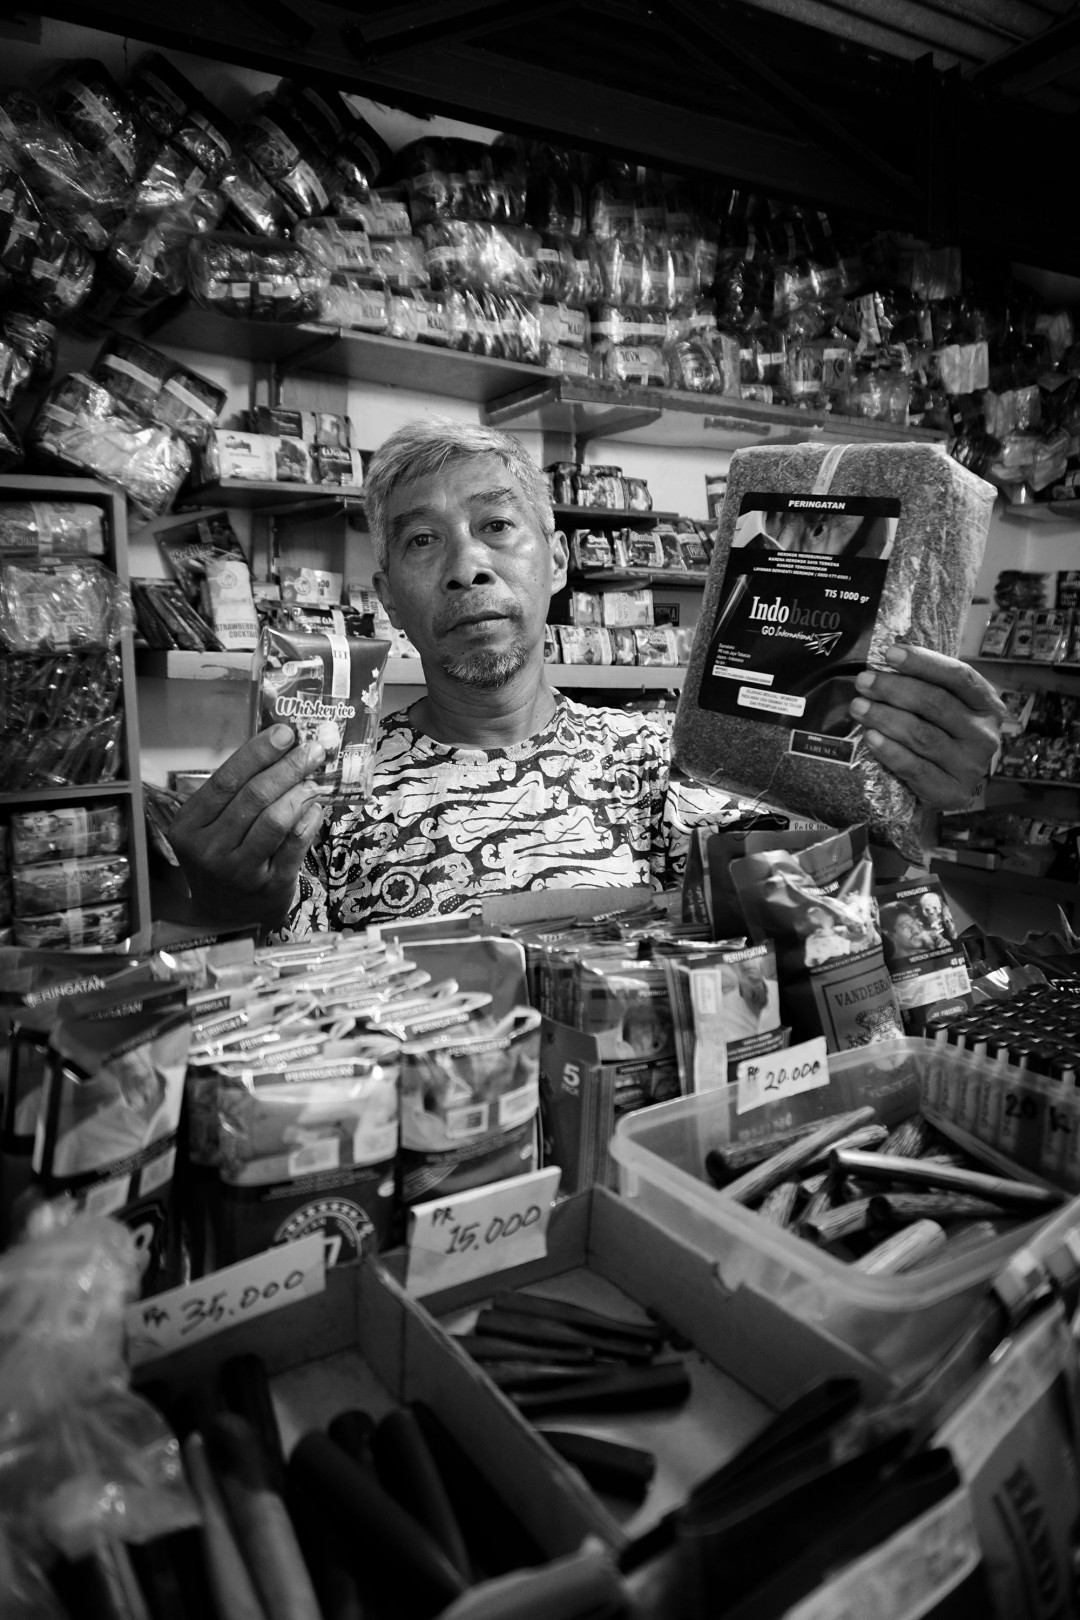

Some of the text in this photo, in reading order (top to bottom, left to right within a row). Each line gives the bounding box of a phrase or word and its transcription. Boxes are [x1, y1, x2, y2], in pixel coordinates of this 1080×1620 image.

[788, 500, 846, 510] PERINGATAN
[825, 589, 870, 604] TIS 1000 gr
[761, 625, 775, 636] GO
[276, 696, 355, 722] Whiskey ice
[563, 1063, 580, 1087] 5
[764, 1060, 820, 1091] 20.000
[445, 1205, 541, 1255] 15.000
[179, 1270, 304, 1336] 35.000
